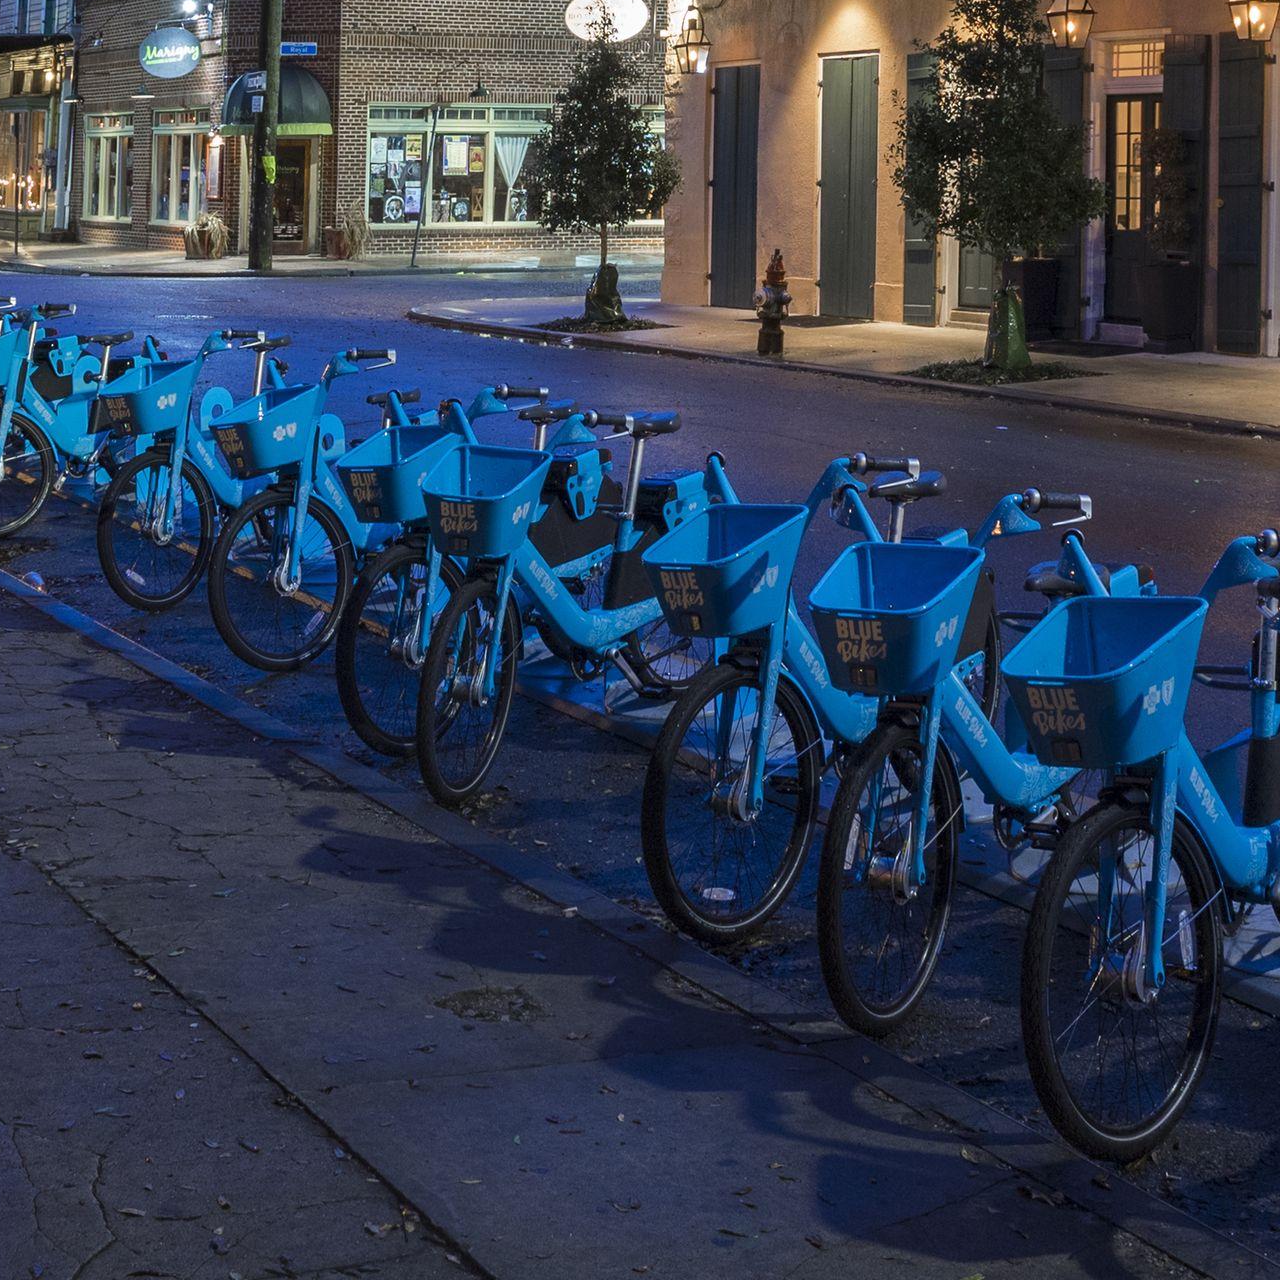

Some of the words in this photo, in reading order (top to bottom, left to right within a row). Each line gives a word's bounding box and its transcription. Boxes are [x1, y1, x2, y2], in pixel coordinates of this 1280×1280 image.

[143, 45, 199, 61] Marigny
[290, 46, 308, 55] Royal
[106, 398, 127, 409] BLUE
[218, 429, 239, 441] BLUE
[350, 473, 377, 487] BLUE
[353, 486, 382, 503] Bikes
[441, 501, 475, 518] BLUE
[441, 516, 477, 534] Bikes
[660, 571, 699, 589] BLUE
[664, 588, 704, 610] Bikes
[836, 618, 883, 641] BLUE
[837, 636, 887, 663] Bikes
[1026, 687, 1079, 711] BLUE
[955, 697, 972, 724] BLUE
[1032, 708, 1086, 736] Bikes
